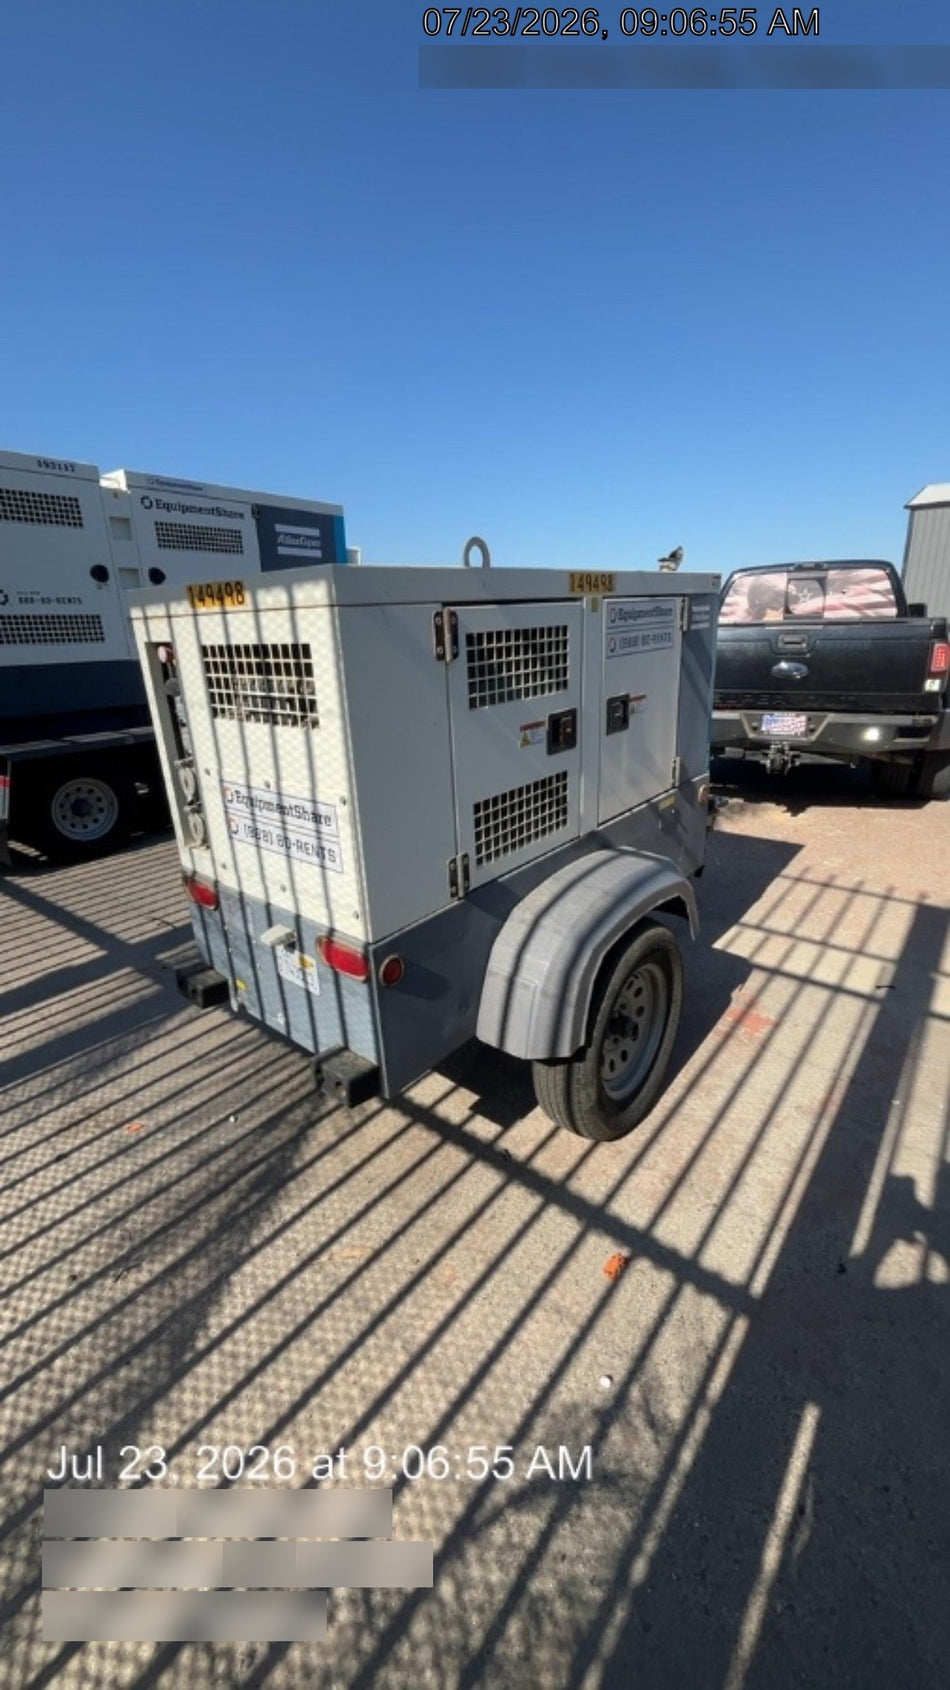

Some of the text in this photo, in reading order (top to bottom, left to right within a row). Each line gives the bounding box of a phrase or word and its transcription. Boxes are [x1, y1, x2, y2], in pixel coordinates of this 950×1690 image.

[155, 499, 245, 519] EquipmentShare
[570, 573, 614, 592] 149498
[188, 581, 245, 608] 149498
[617, 606, 673, 622] EquipmentShare
[234, 790, 332, 827] EquipmentShare
